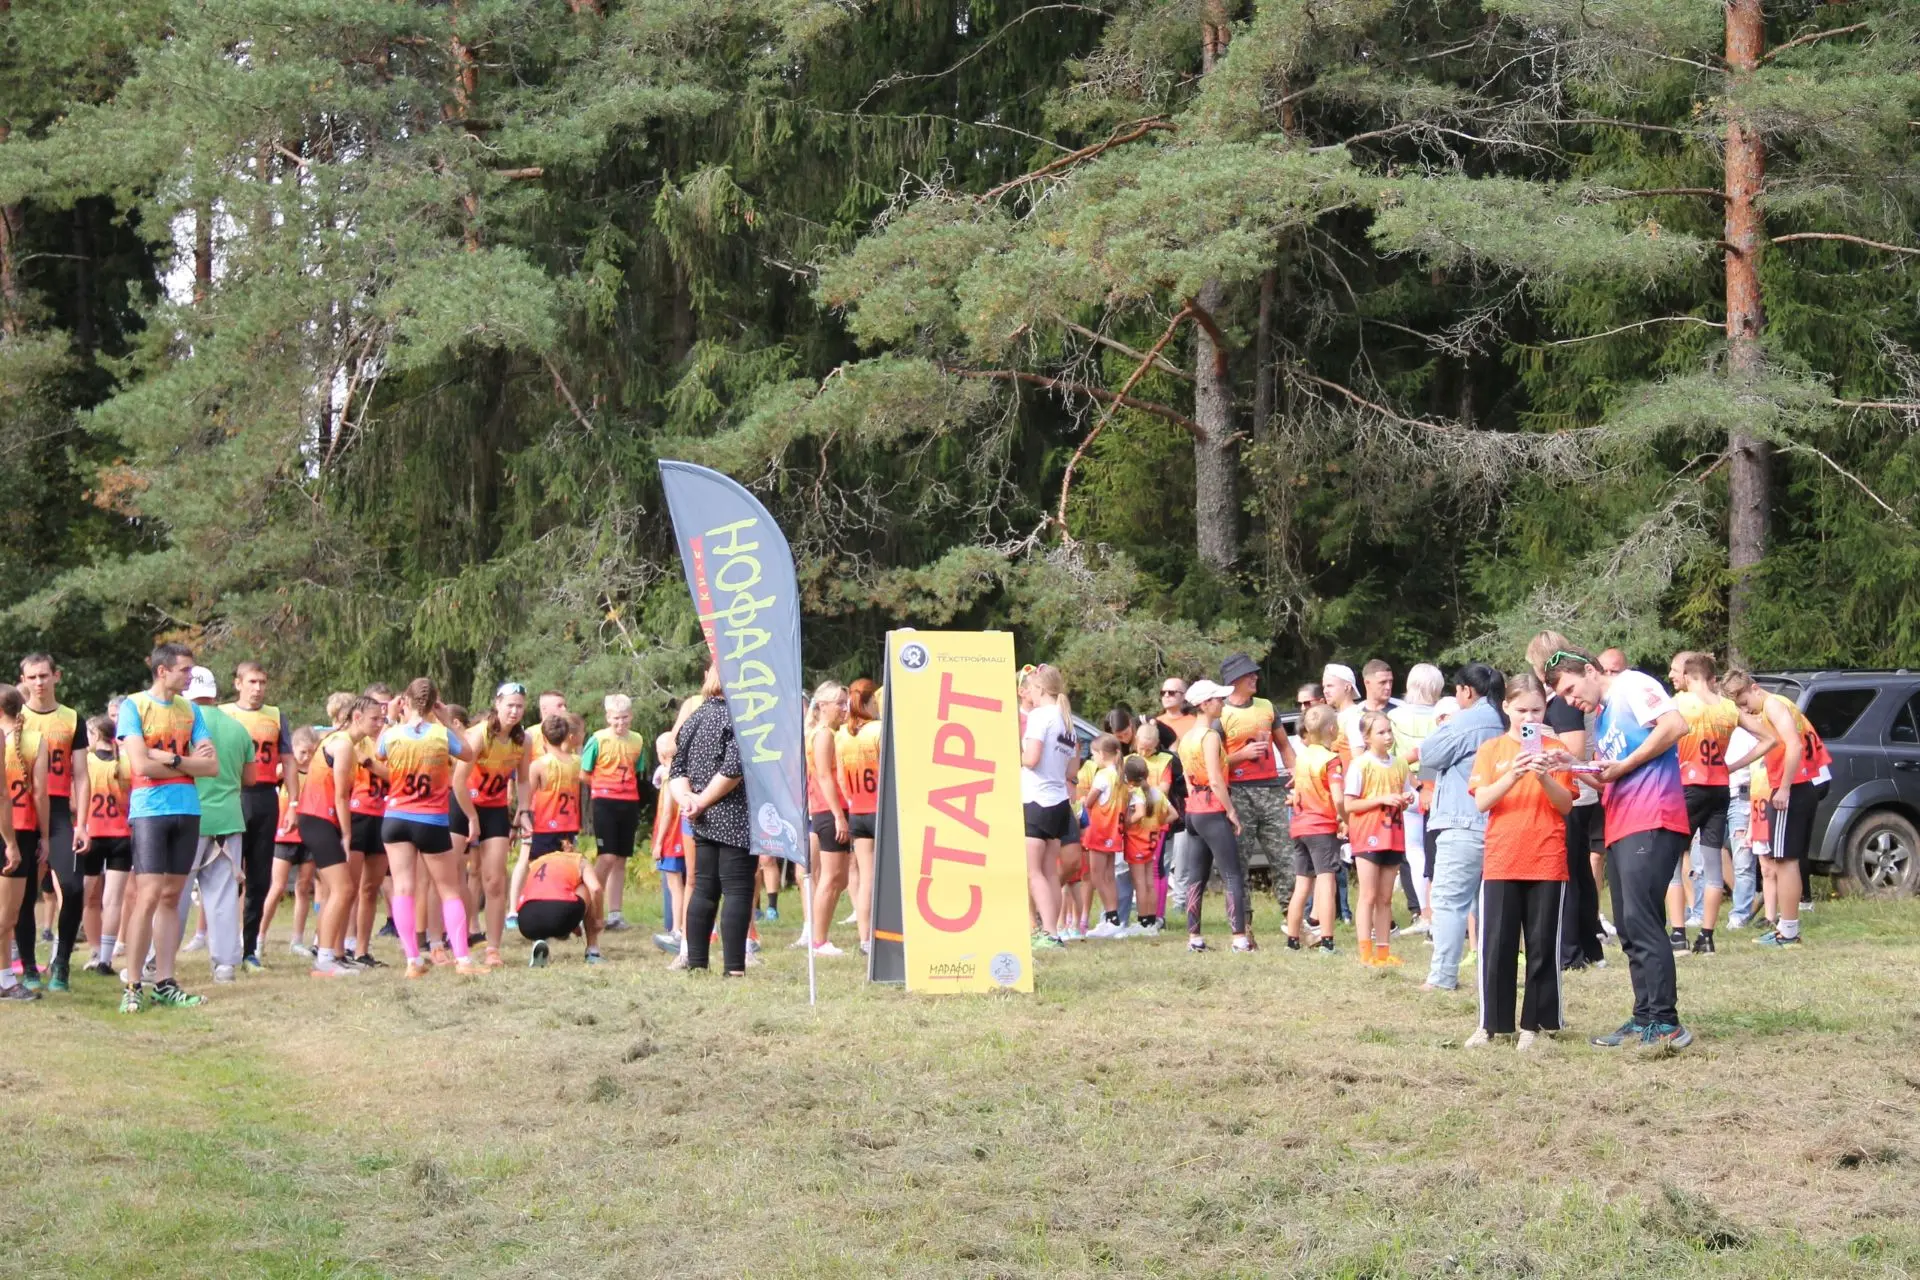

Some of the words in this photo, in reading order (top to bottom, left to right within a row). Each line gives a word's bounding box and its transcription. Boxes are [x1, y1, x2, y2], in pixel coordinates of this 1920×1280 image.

[936, 654, 1007, 664] ТЕХСТРОЙМАШ
[1700, 739, 1723, 766] 92
[402, 773, 431, 798] 36
[618, 765, 628, 784] 7
[847, 768, 877, 795] 116
[92, 794, 118, 818] 28
[916, 672, 1003, 933] СТАРТ
[1753, 798, 1767, 821] 59
[534, 863, 548, 882] 4
[929, 962, 976, 982] МАРАФОН
